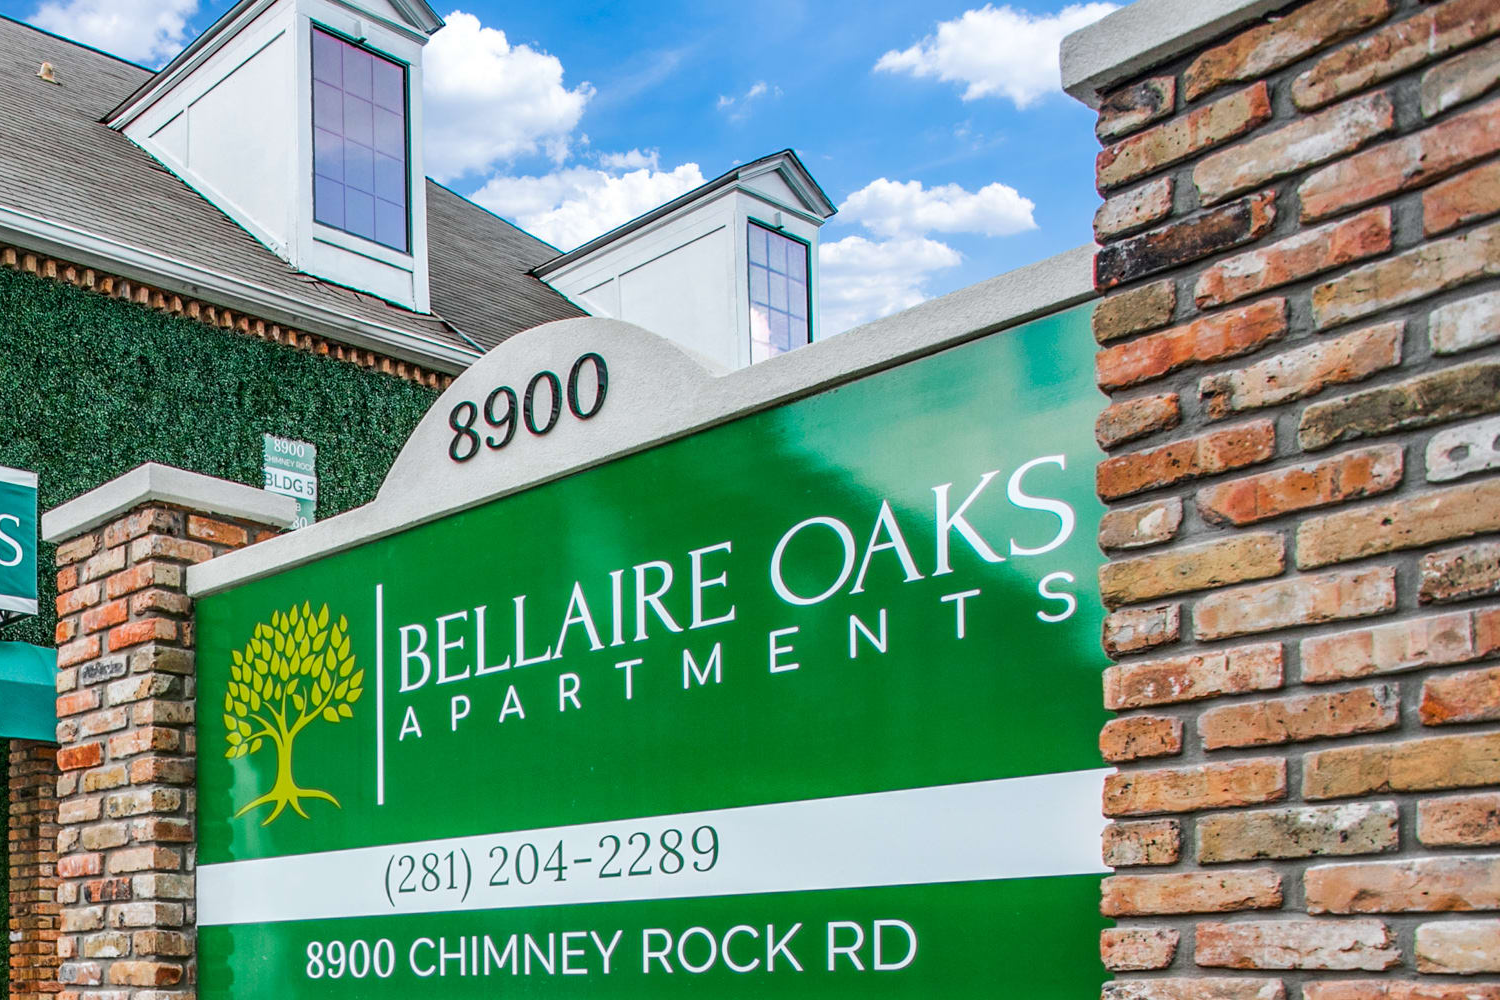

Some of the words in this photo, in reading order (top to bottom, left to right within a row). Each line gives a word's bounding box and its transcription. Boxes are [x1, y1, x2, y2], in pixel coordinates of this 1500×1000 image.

[274, 438, 305, 458] 8900
[448, 352, 609, 463] 8900
[263, 472, 303, 494] BLDG
[307, 481, 315, 496] 5
[399, 541, 737, 693] BELLAIRE
[770, 450, 1078, 606] OAKS
[399, 570, 1078, 741] APARTMENTS
[384, 847, 473, 907] (281)
[489, 825, 721, 888] 204-2289
[306, 938, 396, 979] 8900
[409, 930, 623, 977] CHIMNEY
[643, 922, 804, 974] ROCK
[827, 919, 918, 972] RD
